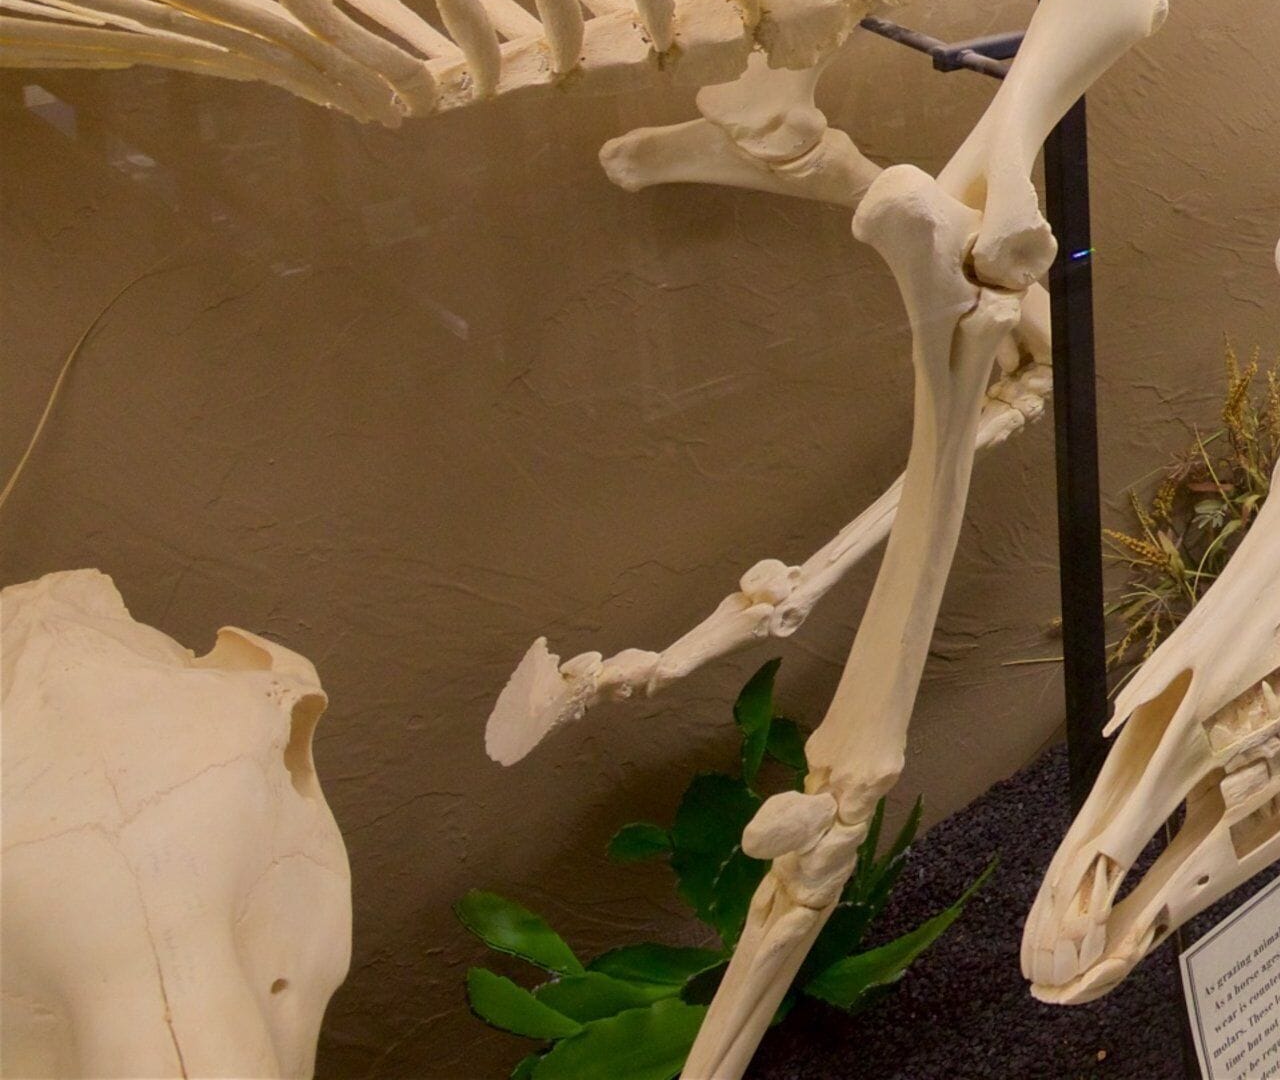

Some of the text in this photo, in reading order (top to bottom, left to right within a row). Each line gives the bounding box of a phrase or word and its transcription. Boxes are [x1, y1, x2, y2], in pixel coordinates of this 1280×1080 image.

[1216, 954, 1251, 989] grazing
[1233, 970, 1259, 995] horse
[1214, 1009, 1237, 1032] wear
[1248, 1002, 1273, 1026] These
[1225, 1049, 1245, 1071] time
[1246, 1033, 1262, 1051] but
[1263, 1018, 1278, 1036] not
